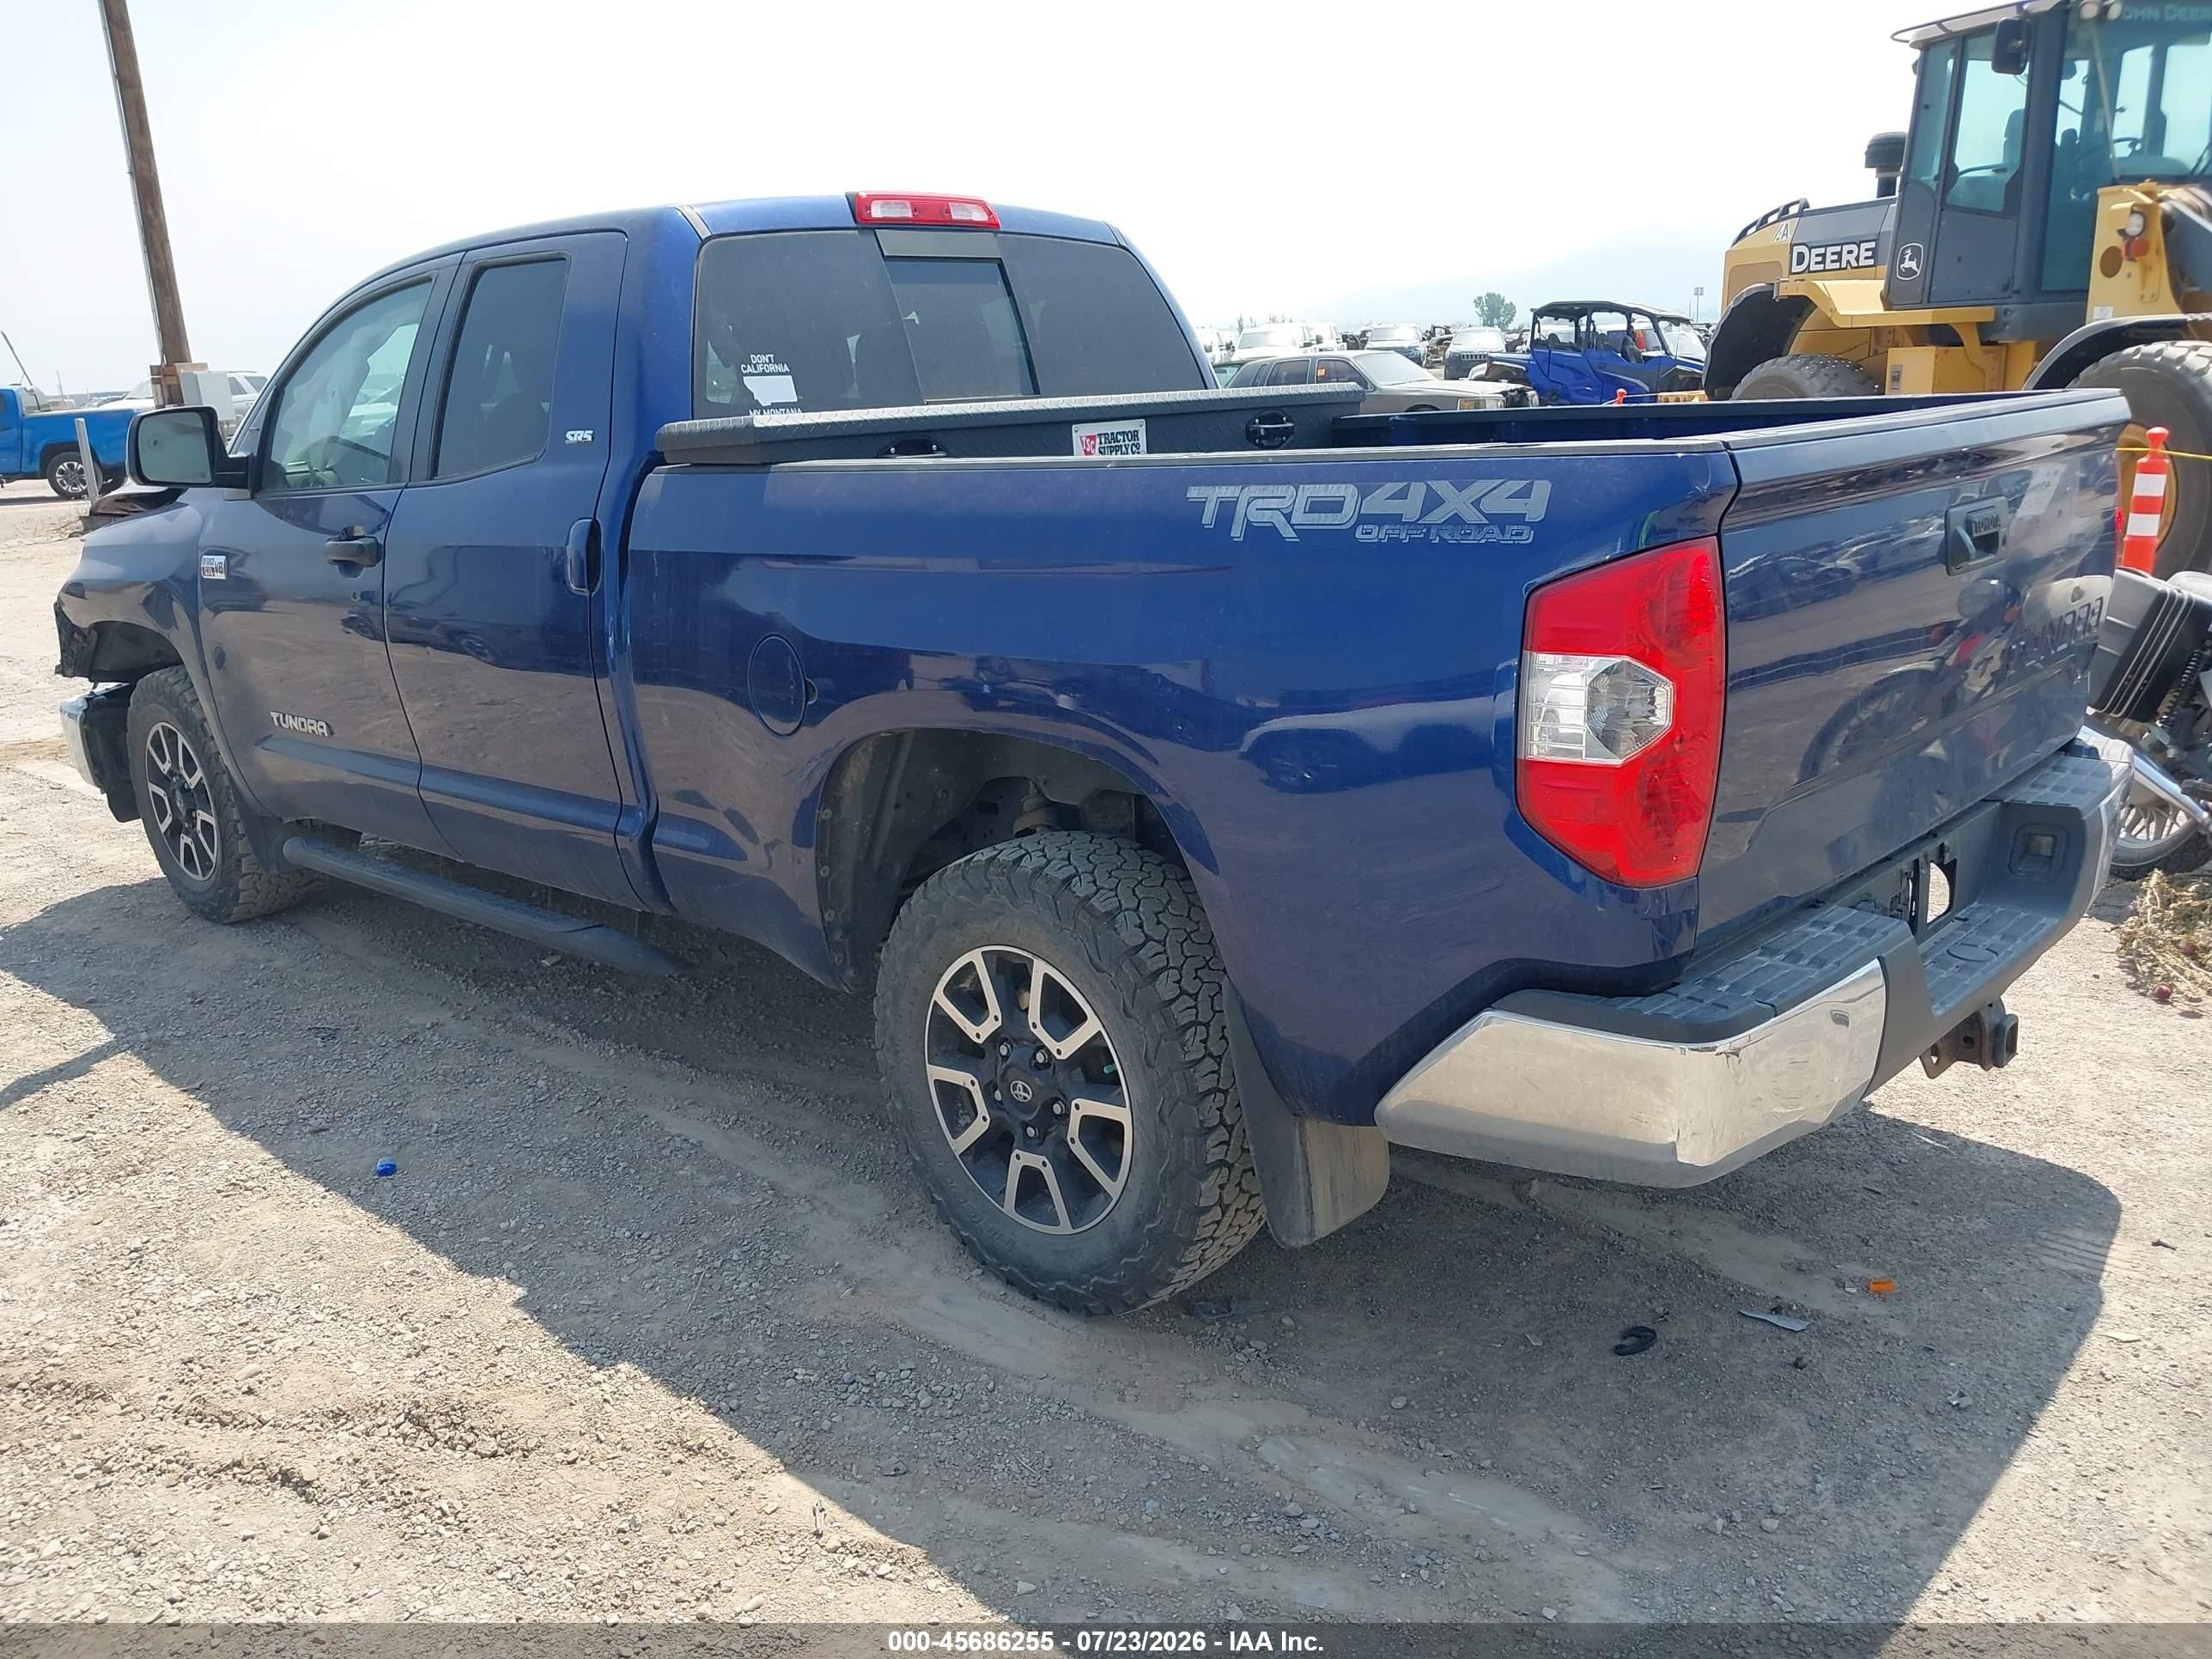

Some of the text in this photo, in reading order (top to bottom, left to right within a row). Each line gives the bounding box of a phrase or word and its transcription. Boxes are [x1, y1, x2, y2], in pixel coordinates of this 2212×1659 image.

[1791, 241, 1876, 273] DEERE
[740, 363, 791, 374] CALIFORNIA
[565, 429, 593, 441] SR5
[1097, 430, 1140, 446] TRACTOR
[1081, 436, 1095, 453] TSC
[1098, 444, 1130, 455] SUPPLY
[1186, 483, 1362, 542] TRD
[1355, 524, 1534, 544] OFF ROAD
[270, 711, 330, 737] TUNDRA
